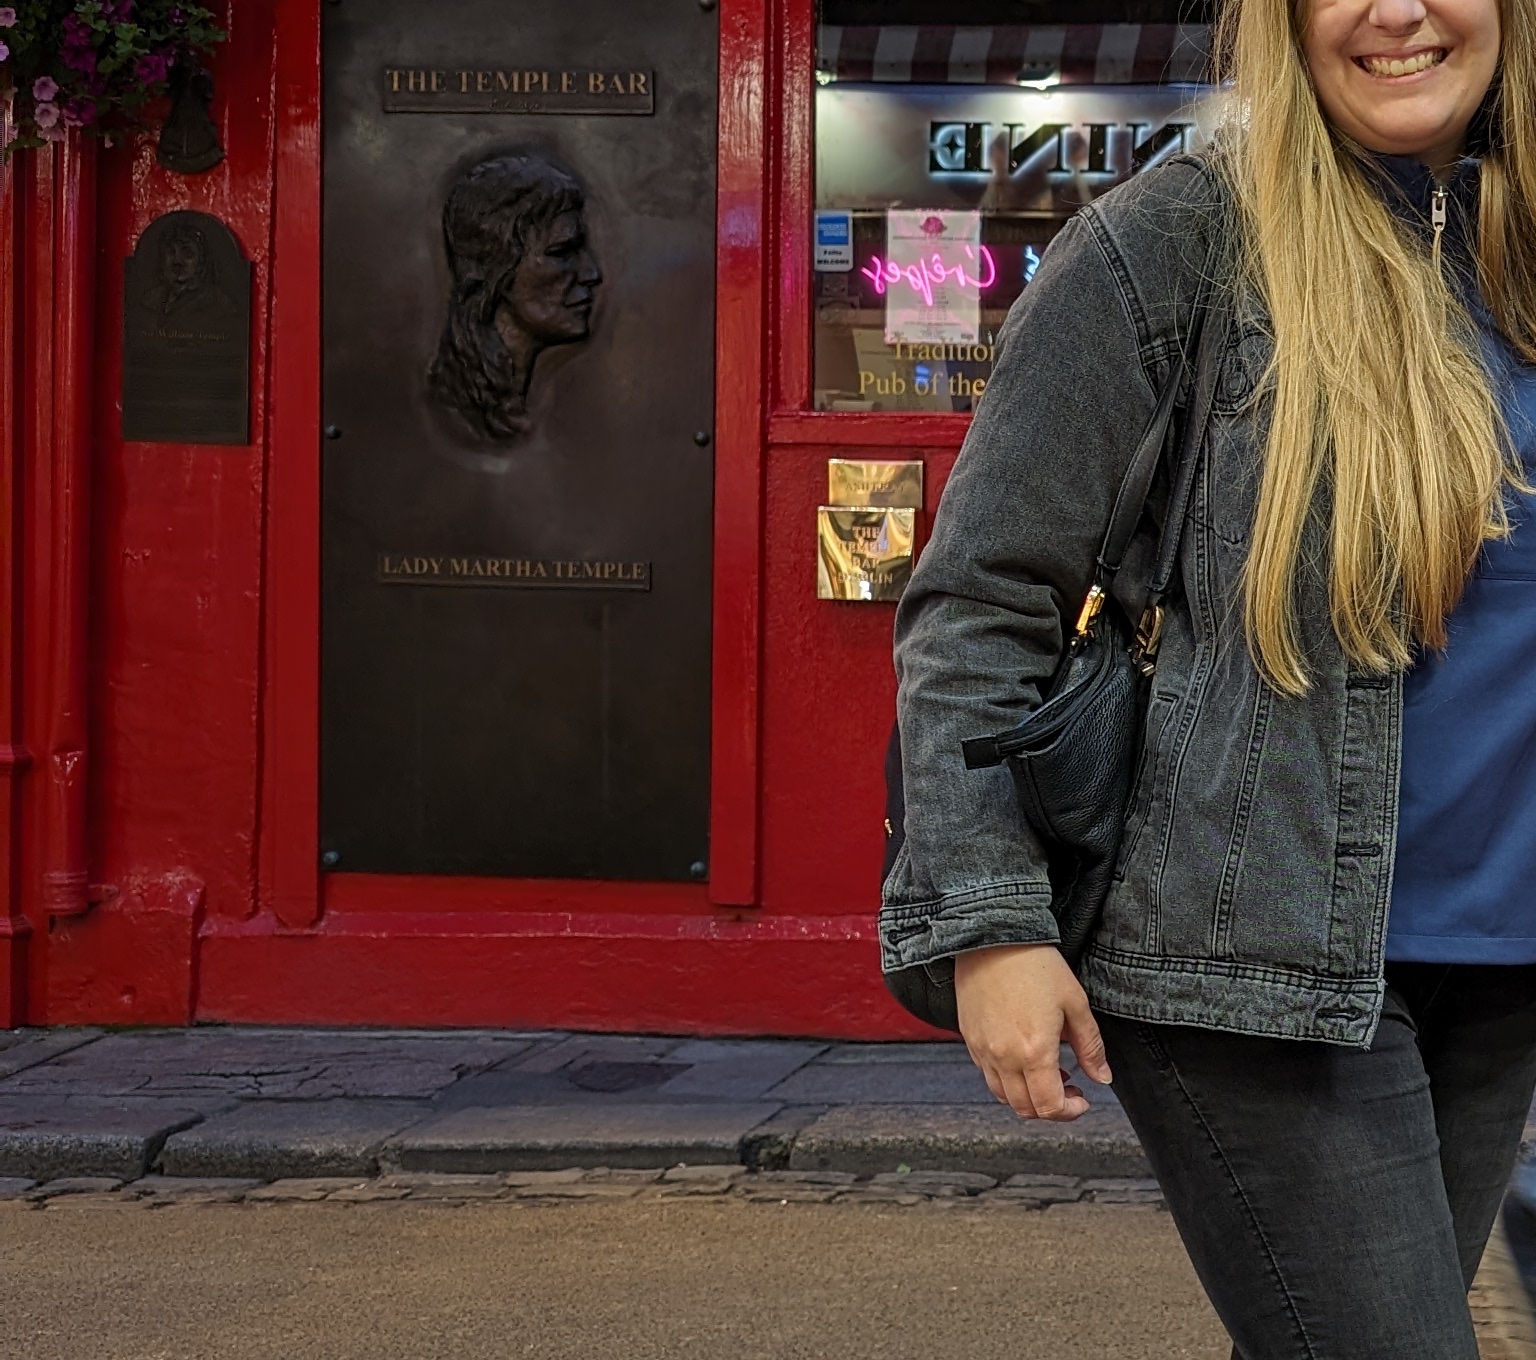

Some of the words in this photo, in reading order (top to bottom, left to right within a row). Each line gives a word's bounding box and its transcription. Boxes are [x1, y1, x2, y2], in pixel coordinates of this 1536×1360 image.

[386, 69, 447, 94] THE
[455, 70, 577, 94] TEMPLE
[586, 71, 650, 95] BAR
[860, 370, 906, 396] Pub
[914, 372, 944, 396] of
[948, 372, 986, 397] the
[852, 526, 881, 539] THE
[383, 555, 445, 575] LADY
[449, 558, 548, 577] MARTHA
[551, 561, 646, 581] TEMPLE
